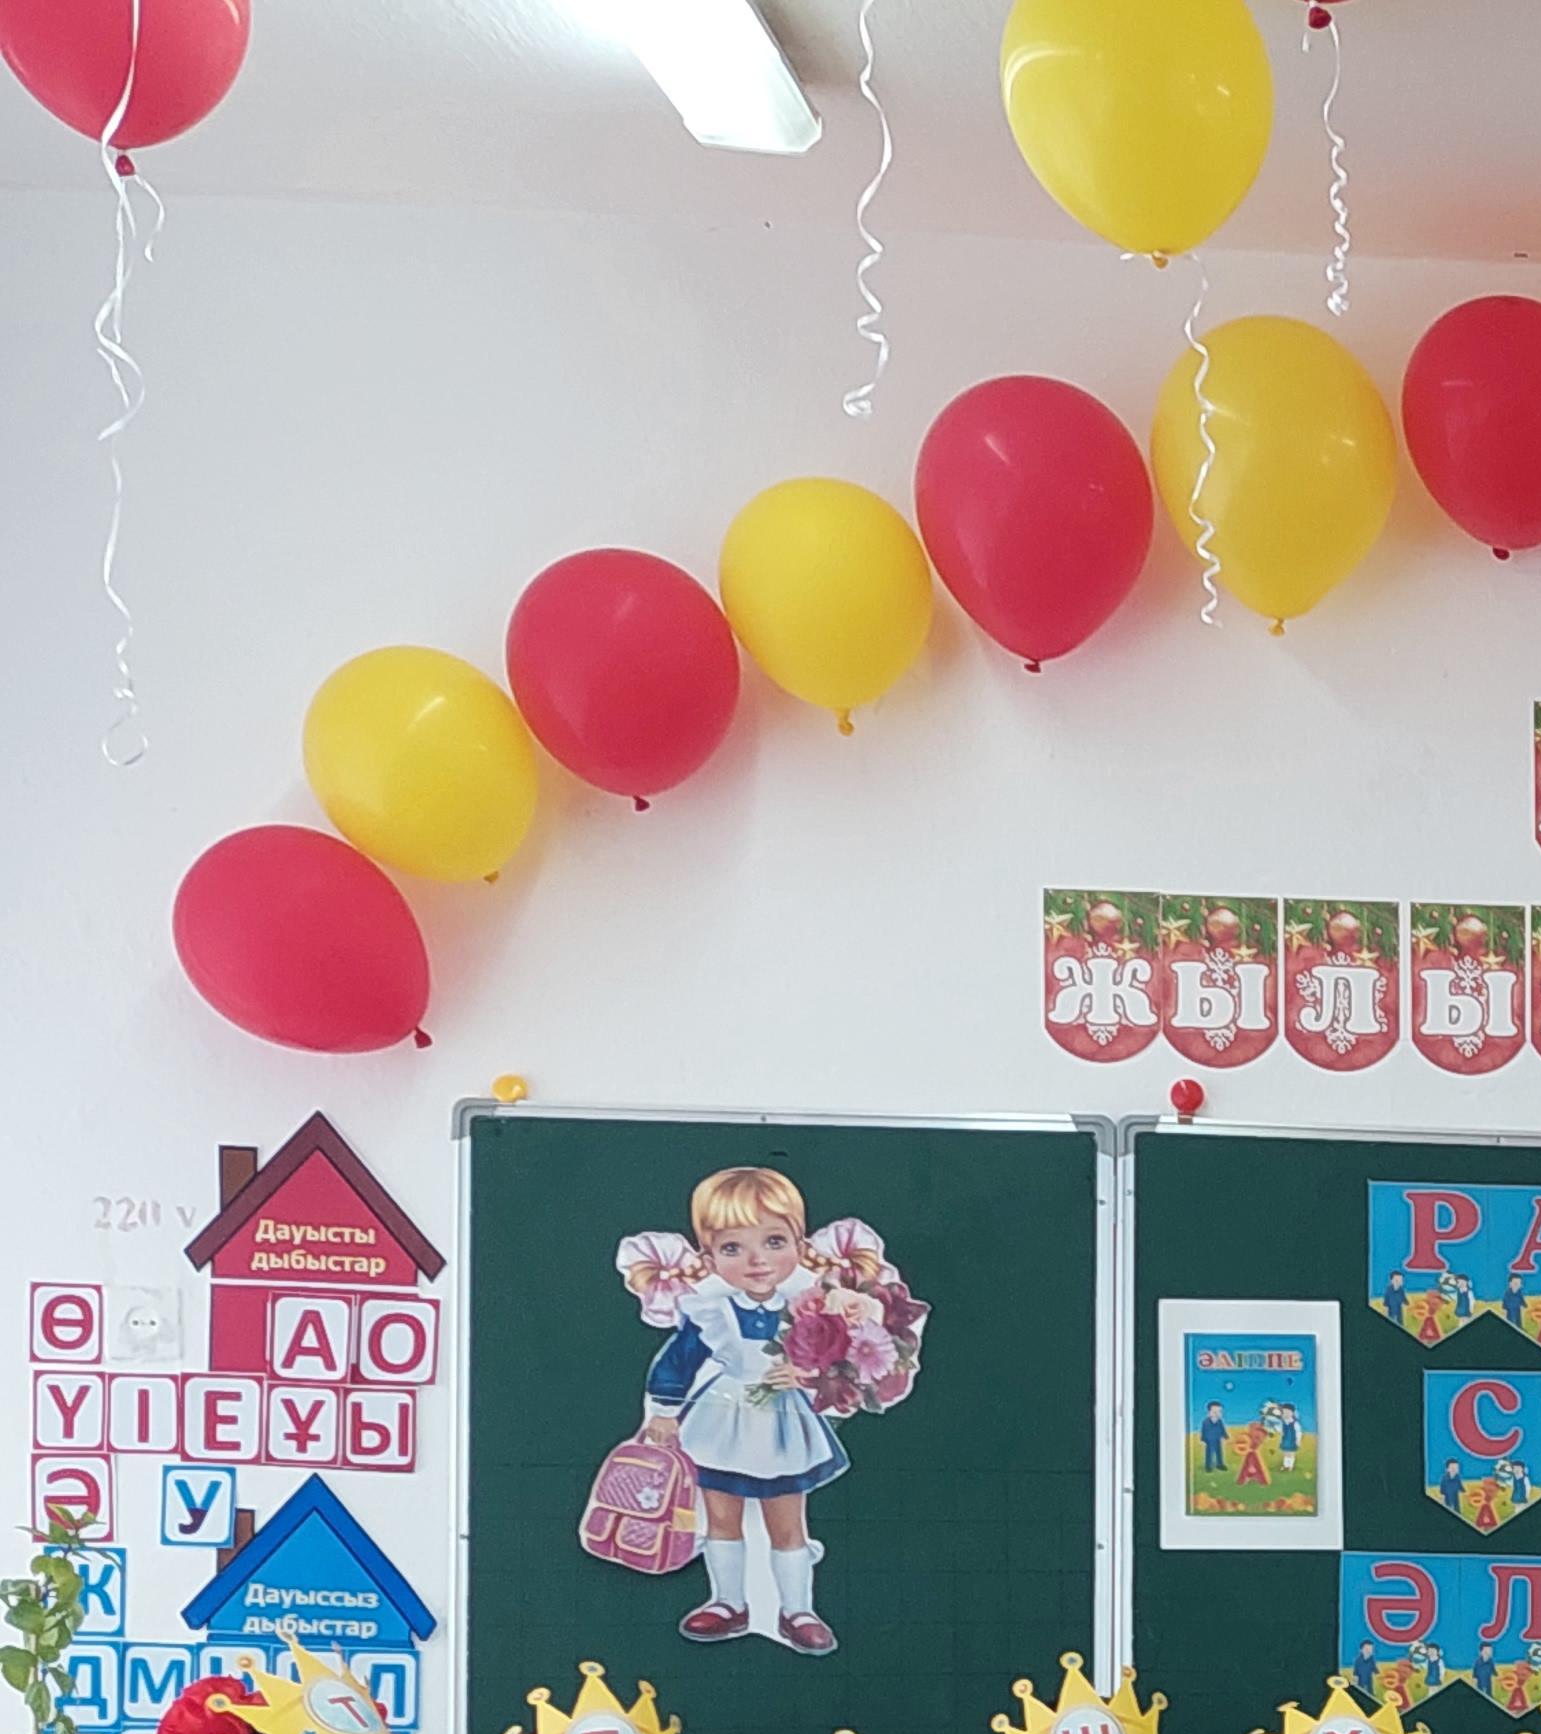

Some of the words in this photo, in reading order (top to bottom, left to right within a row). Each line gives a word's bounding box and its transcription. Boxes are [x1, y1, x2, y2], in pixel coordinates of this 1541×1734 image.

[255, 1217, 377, 1246] Дауысты
[250, 1247, 387, 1277] дыбыстар
[245, 1583, 381, 1609] Дауыссыз
[243, 1613, 378, 1639] дыбыстар
[327, 1695, 370, 1729] Т
